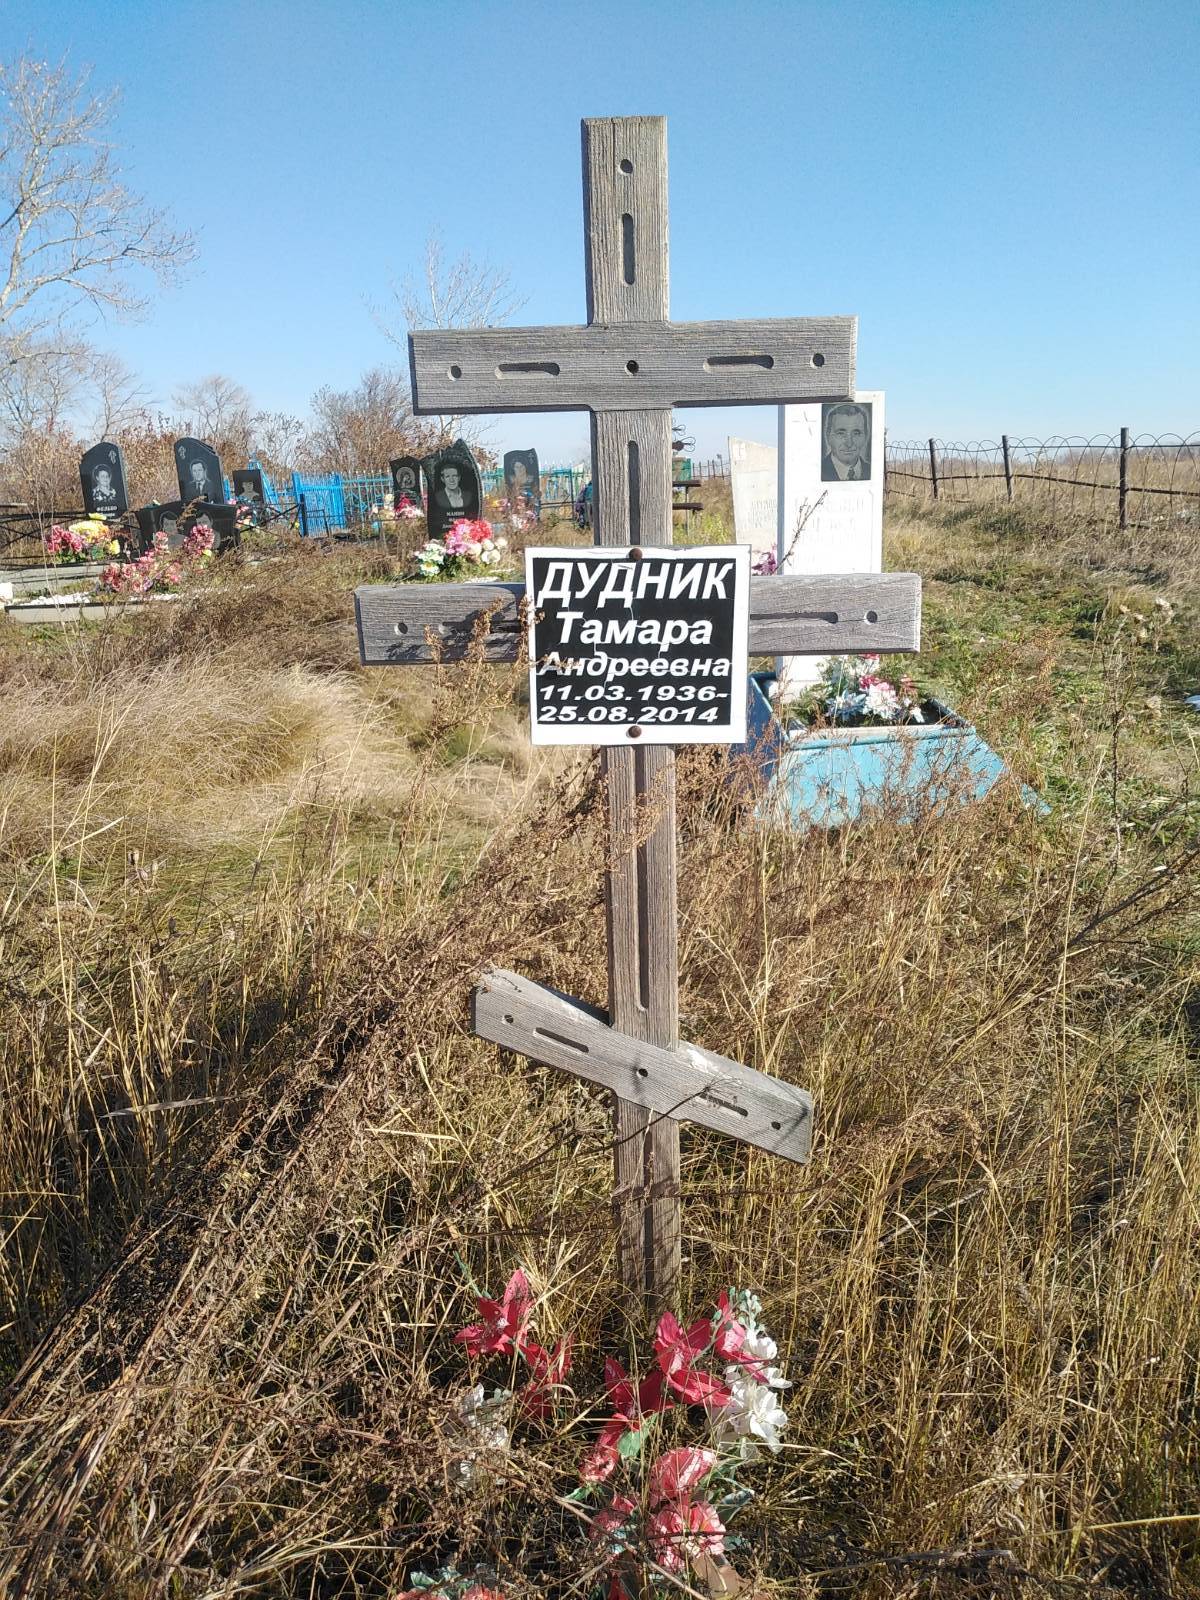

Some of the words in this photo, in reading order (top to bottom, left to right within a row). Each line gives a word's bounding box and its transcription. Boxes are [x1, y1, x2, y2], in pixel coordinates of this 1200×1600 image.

[536, 561, 734, 608] ДУДНИК
[556, 611, 713, 653] Тамара
[536, 651, 731, 682] Андреевна
[539, 684, 729, 701] 11.03.1936-
[537, 705, 719, 723] 25.08.2014
